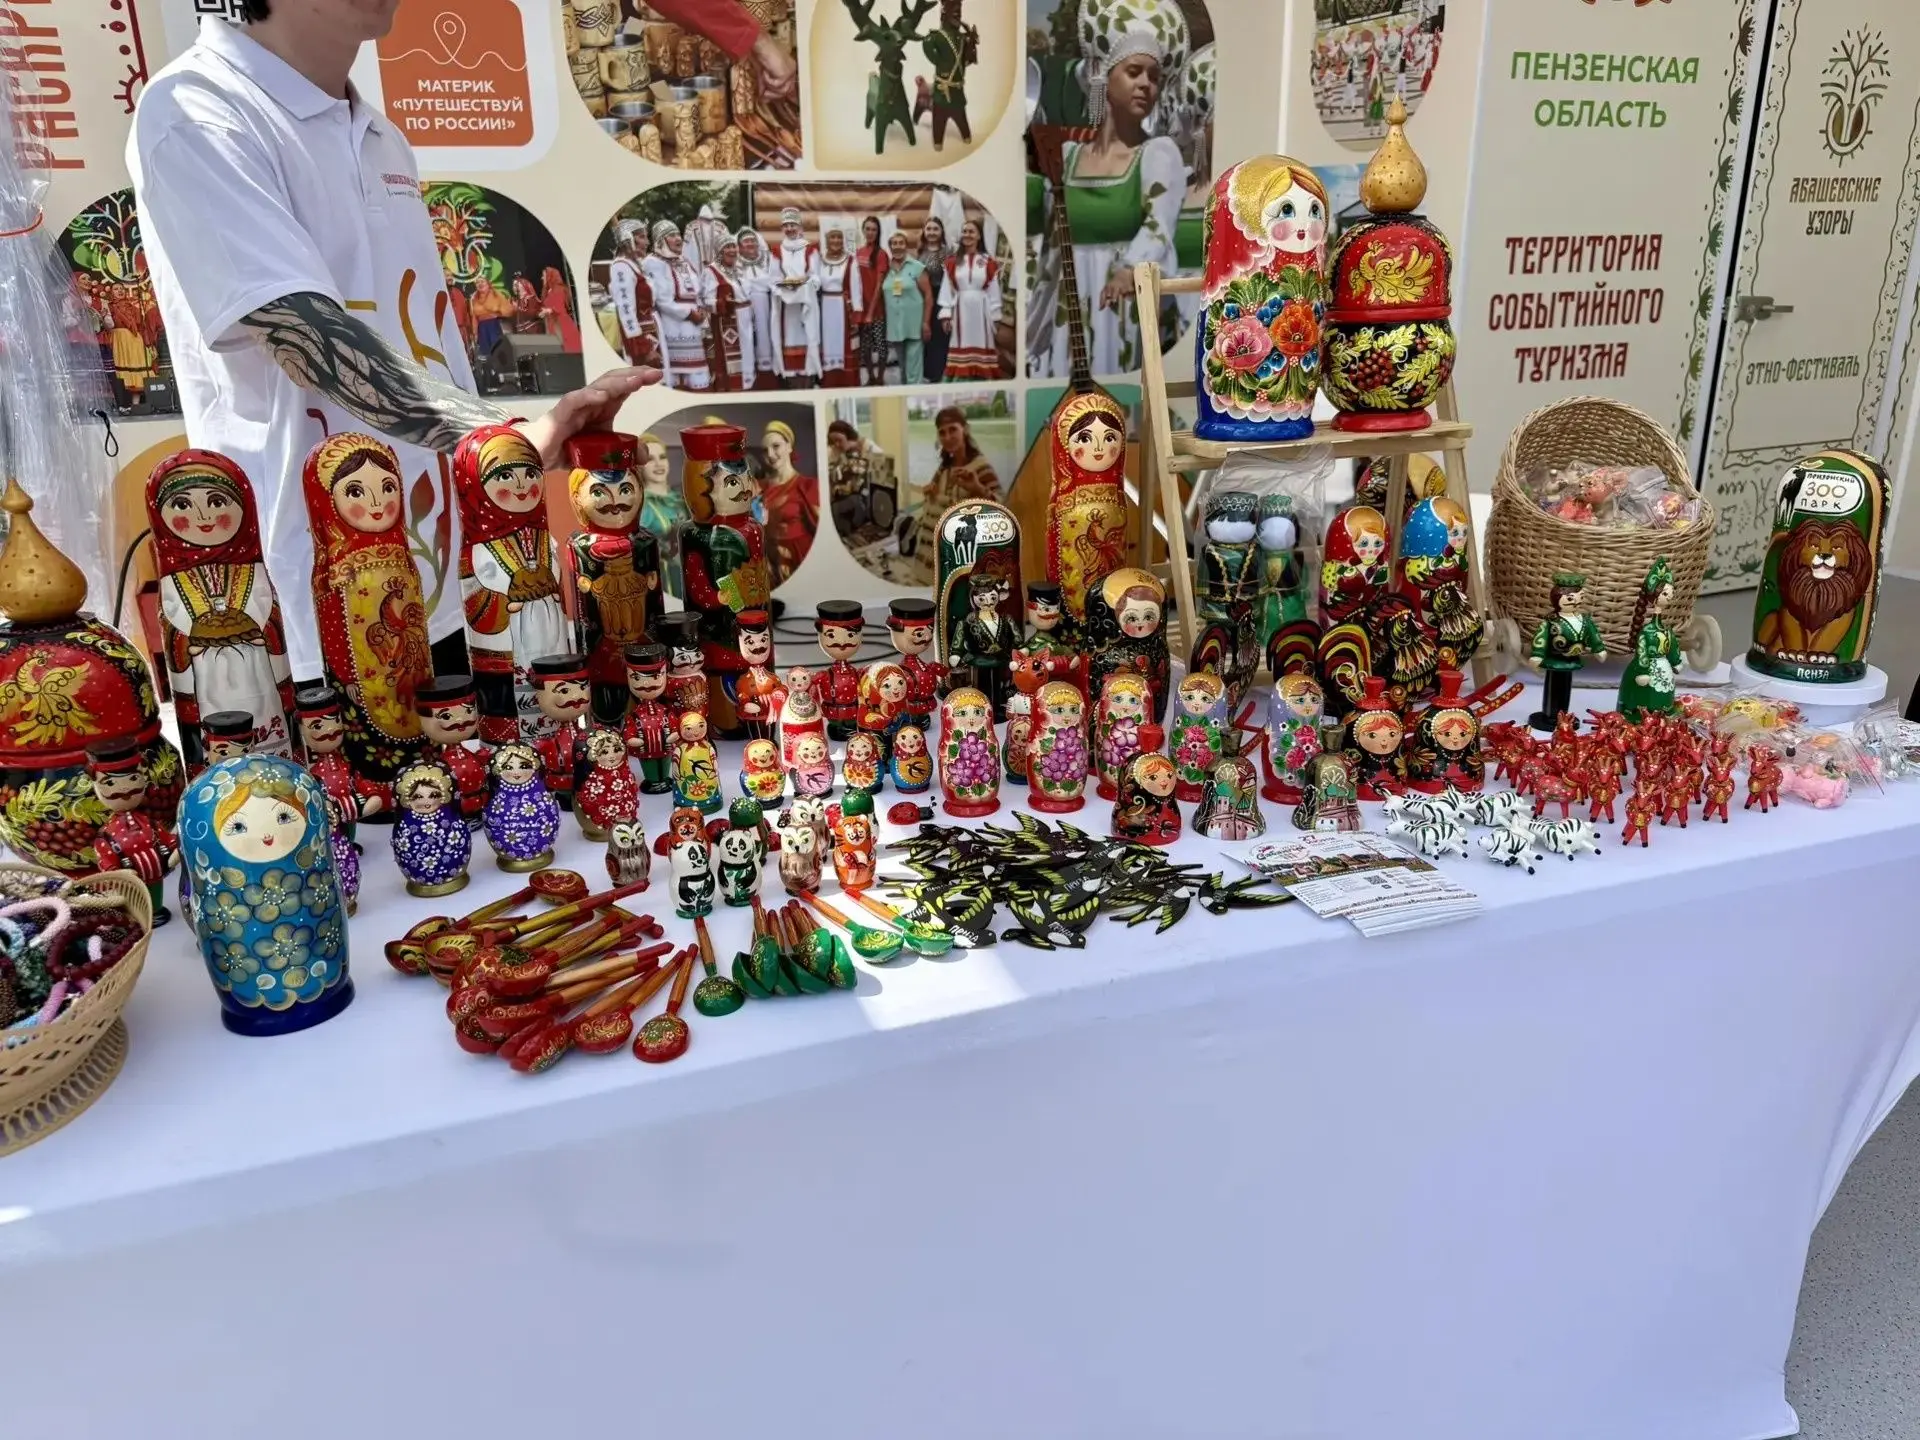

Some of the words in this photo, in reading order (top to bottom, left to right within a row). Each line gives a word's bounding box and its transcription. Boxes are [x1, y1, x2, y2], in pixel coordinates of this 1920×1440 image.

[1510, 51, 1700, 84] ПЕНЗЕНСКАЯ
[0, 0, 86, 169] РАСКР
[417, 79, 496, 93] МАТЕРИК
[393, 96, 524, 112] «ПУТЕШЕСТВУЙ
[1534, 99, 1668, 128] ОБЛАСТЬ
[405, 117, 431, 130] ПО
[434, 117, 516, 131] РОССИИ!»
[1788, 177, 1882, 203] АБАШЕВСКИЕ
[1805, 210, 1855, 236] УЗОРЫ
[1505, 234, 1663, 276] ТЕРРИТОРИЯ
[1488, 281, 1664, 332] СОБЫТИЙНОГО
[1514, 342, 1629, 384] ТУРИЗМА
[1746, 355, 1860, 386] ЭТНО-ФЕСТИВАЛЬ
